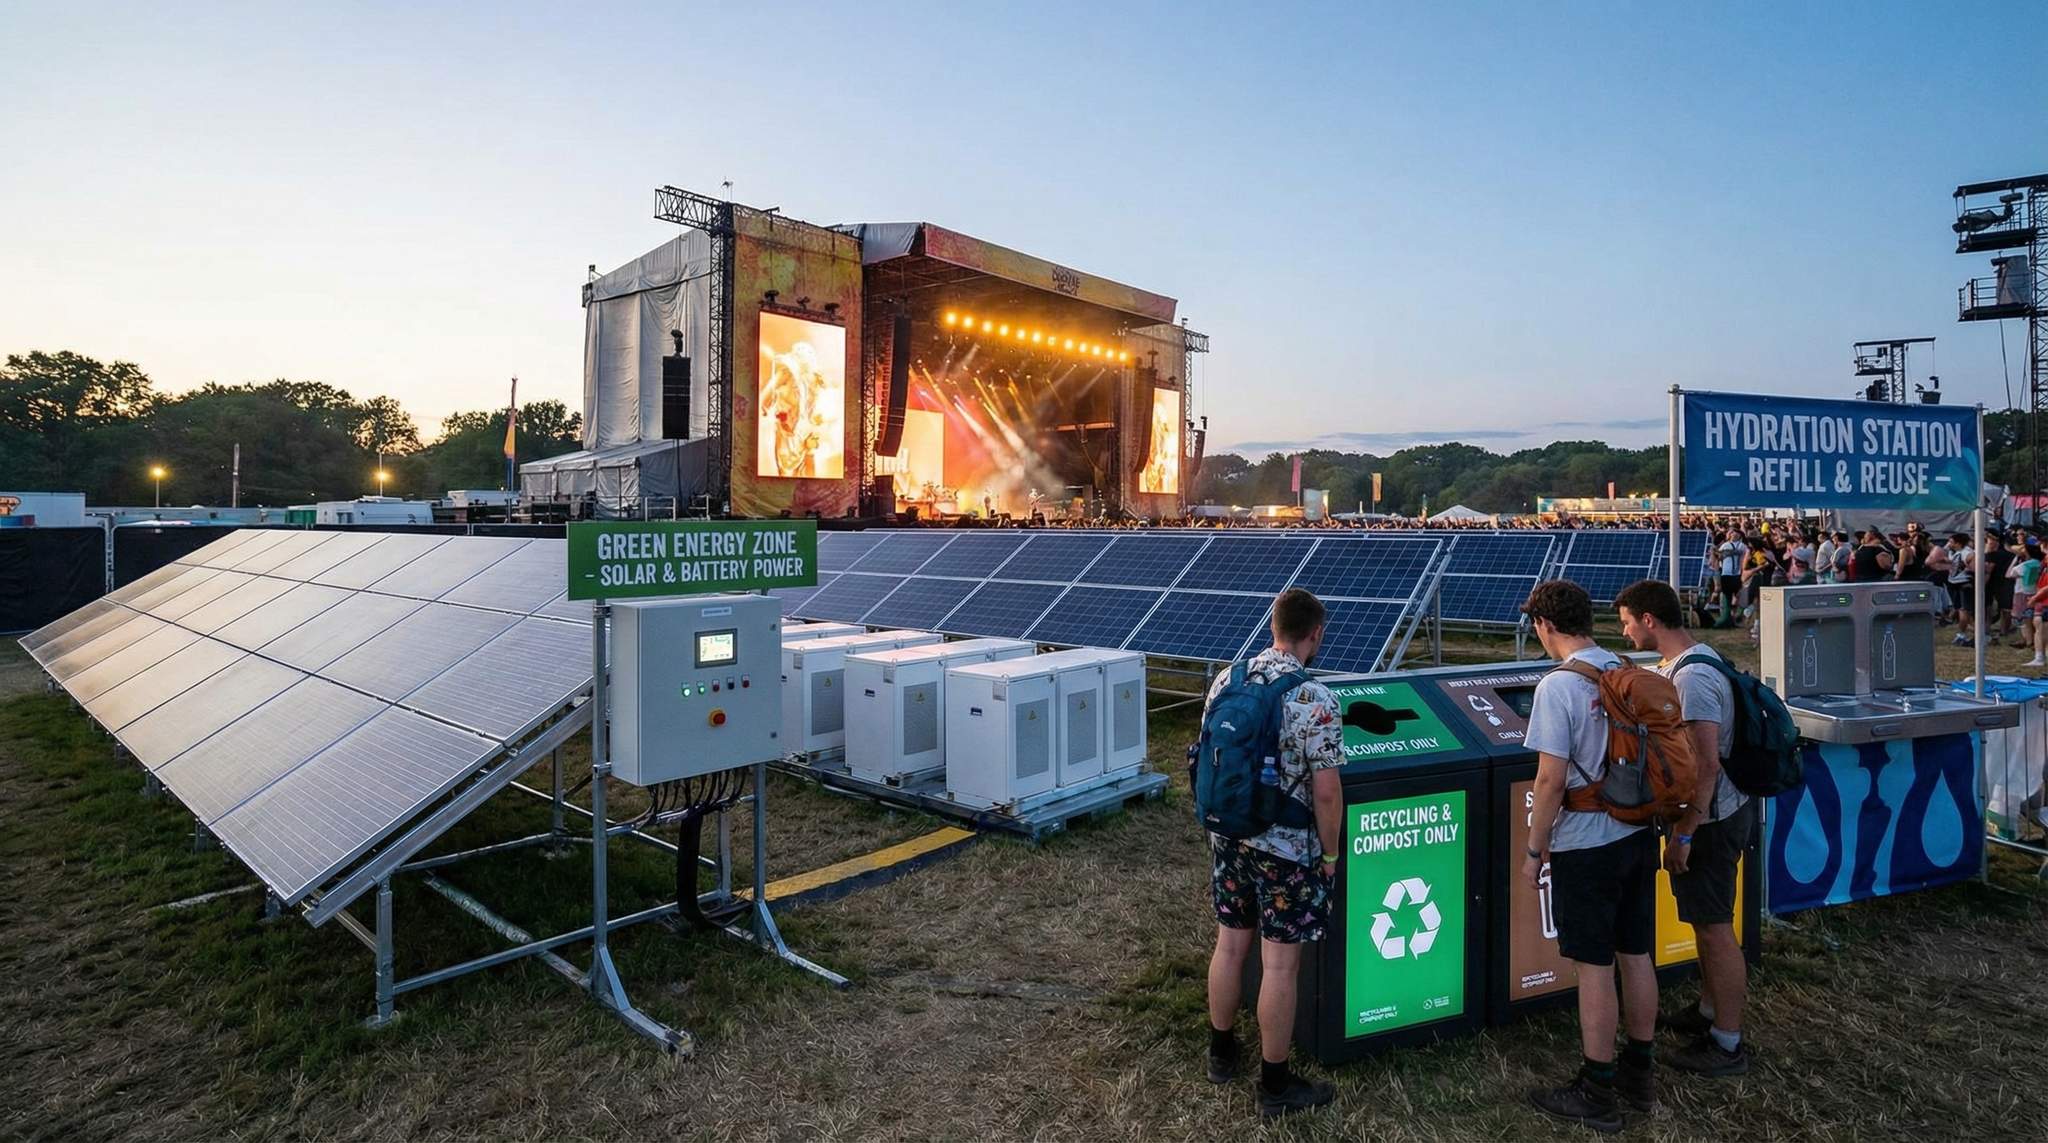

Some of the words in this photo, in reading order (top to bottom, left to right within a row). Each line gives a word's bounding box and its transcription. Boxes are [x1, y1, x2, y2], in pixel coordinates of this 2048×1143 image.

[1705, 411, 1854, 454] HYDRATION
[1862, 418, 1962, 458] STATION
[1749, 457, 1826, 492] REFILL
[1834, 461, 1852, 493] &
[1861, 461, 1930, 495] REUSE
[598, 533, 666, 560] GREEN
[673, 531, 747, 558] ENERGY
[752, 530, 797, 555] ZONE
[600, 563, 656, 586] SOLAR
[662, 561, 677, 583] &
[681, 559, 749, 582] BATTERY
[753, 557, 803, 578] POWER
[1360, 805, 1439, 832] RECYCLING
[1441, 803, 1452, 821] &
[1353, 829, 1421, 855] COMPOST
[1424, 823, 1459, 844] ONLY
